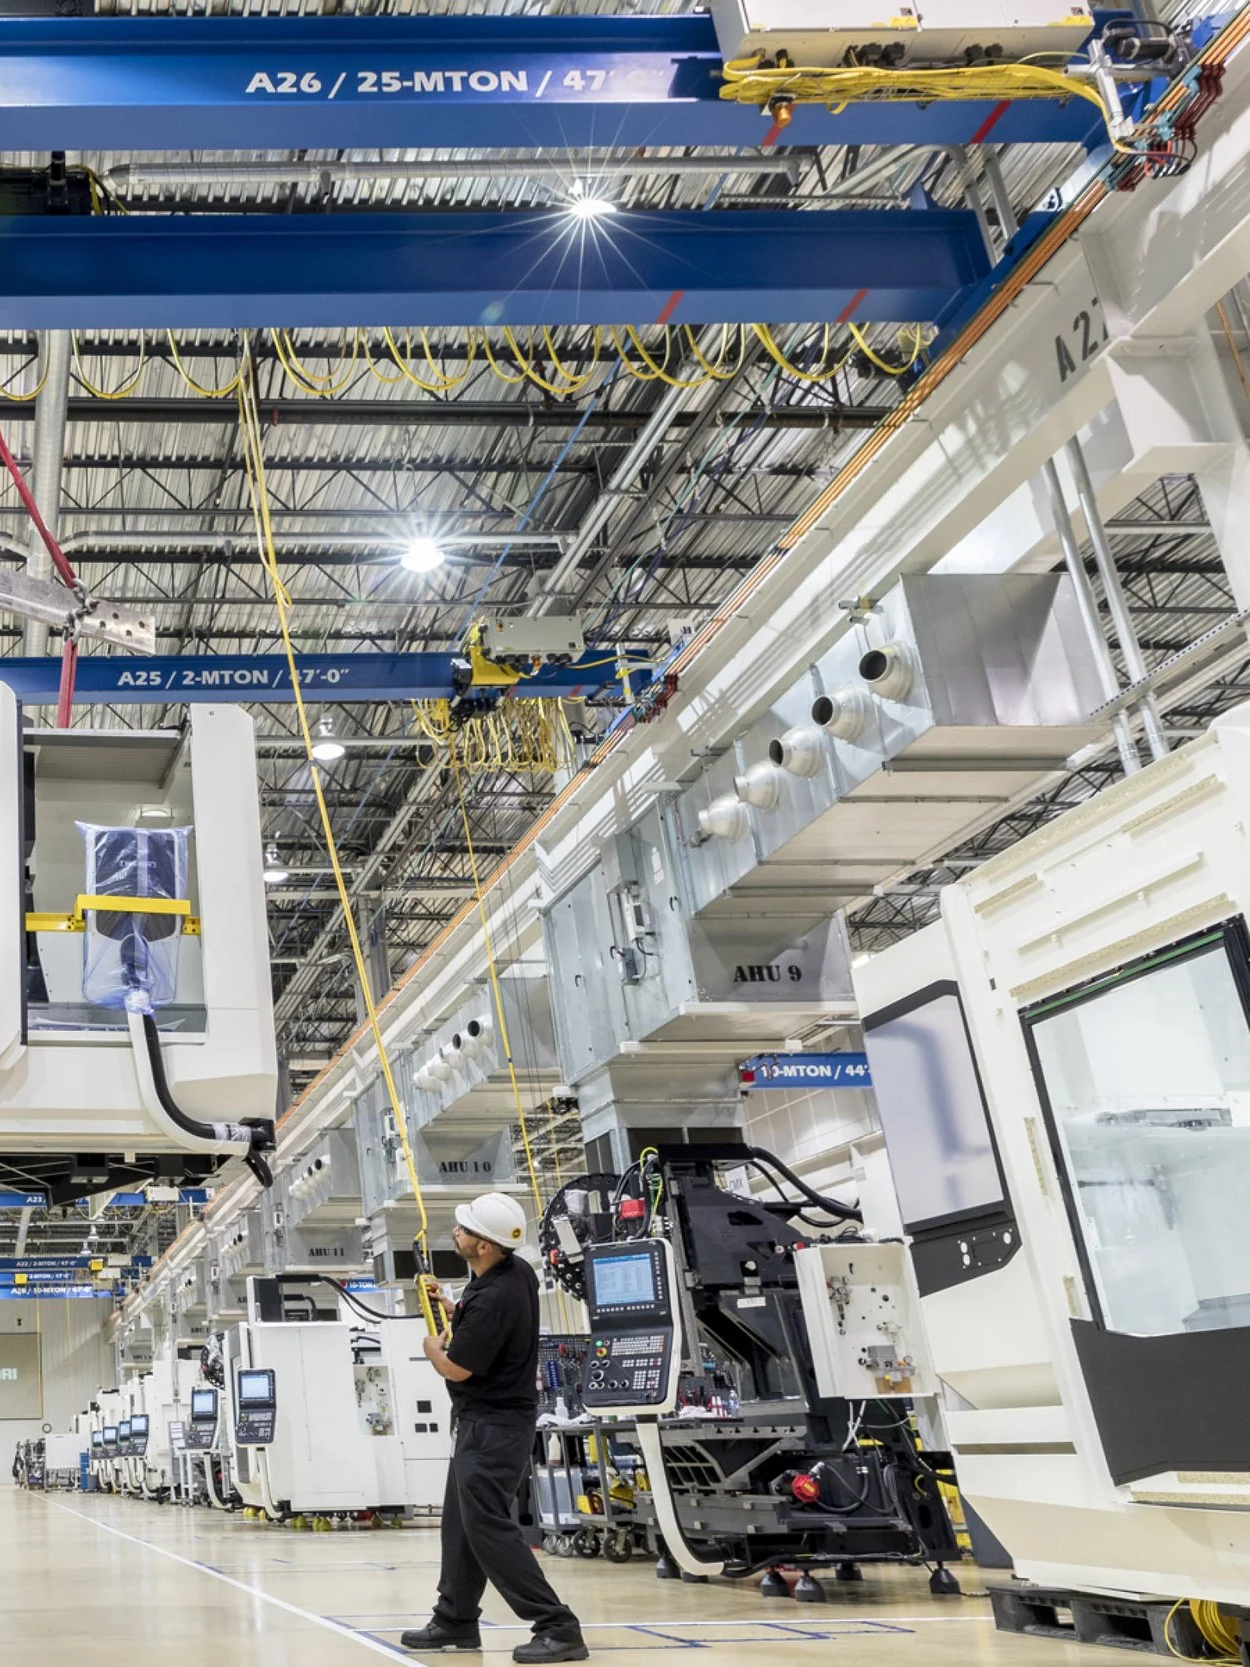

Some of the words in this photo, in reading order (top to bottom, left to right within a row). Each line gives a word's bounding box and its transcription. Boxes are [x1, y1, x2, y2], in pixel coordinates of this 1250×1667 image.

[245, 71, 322, 94] A26
[327, 71, 347, 100] /
[357, 70, 529, 94] 25-MTON
[534, 70, 553, 98] /
[117, 671, 162, 686] A25
[165, 671, 177, 690] /
[182, 670, 269, 685] 2-MTON
[272, 669, 283, 689] /
[734, 965, 781, 982] AHU
[787, 965, 802, 982] 9
[439, 1161, 468, 1173] AHU
[473, 1161, 491, 1173] 10
